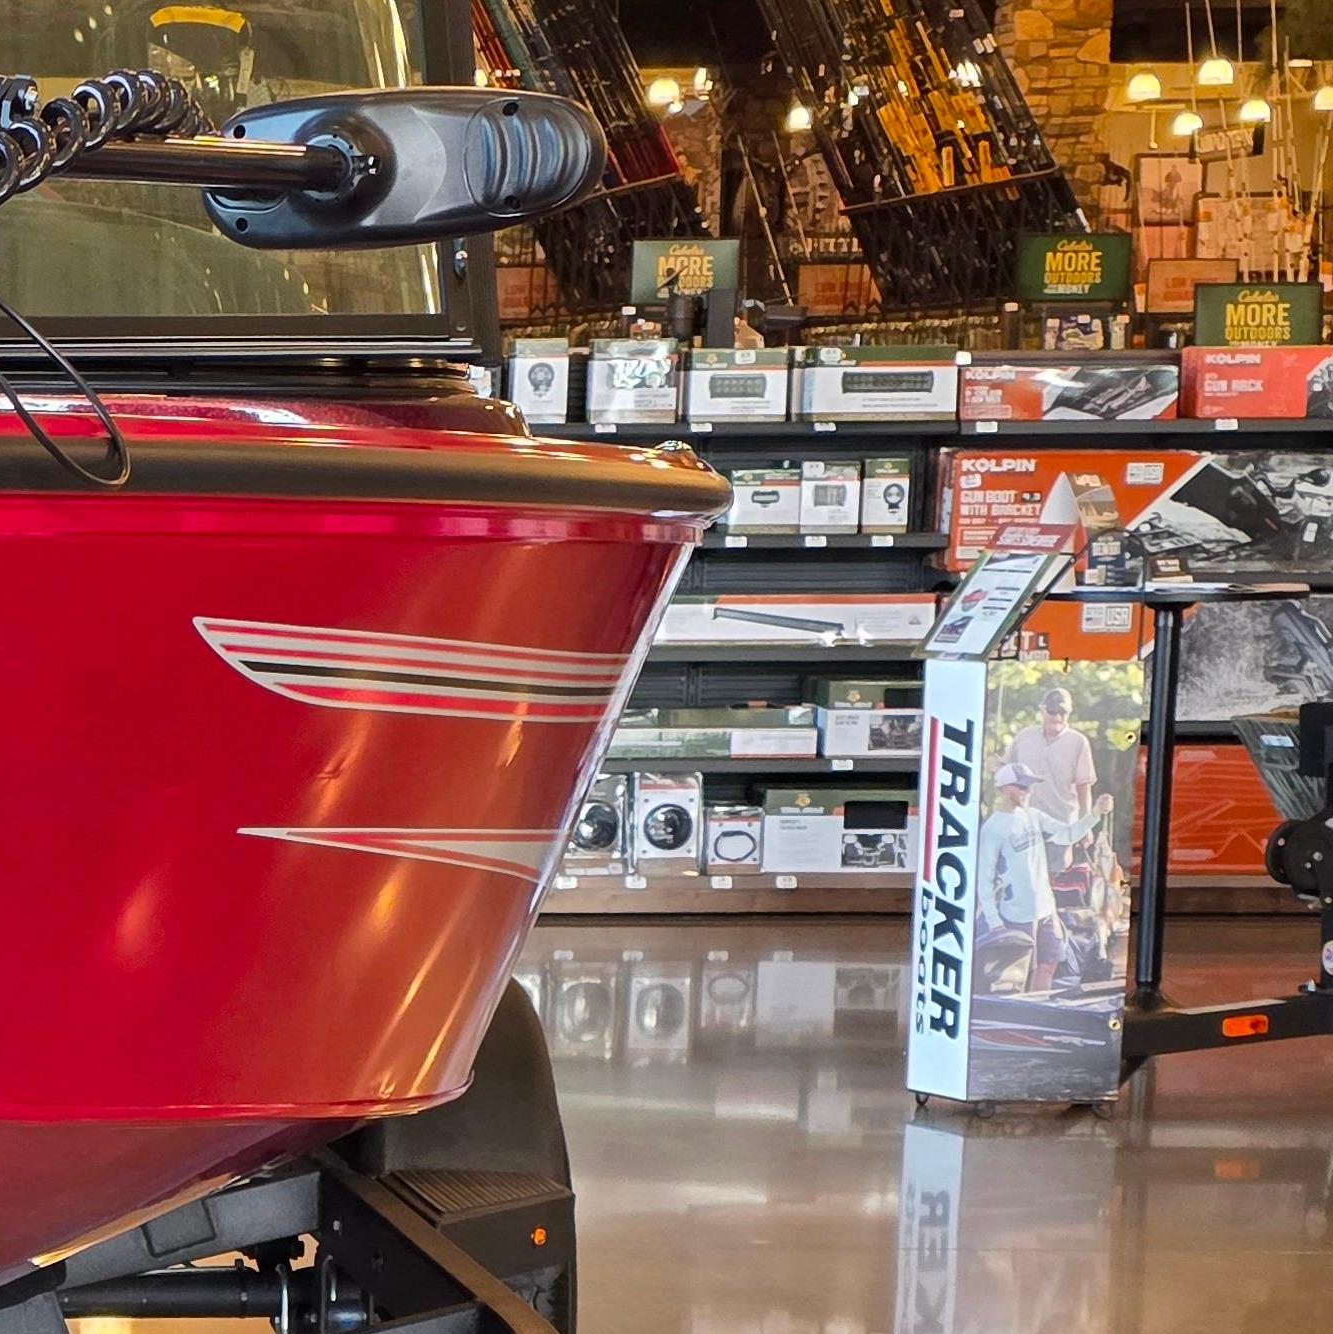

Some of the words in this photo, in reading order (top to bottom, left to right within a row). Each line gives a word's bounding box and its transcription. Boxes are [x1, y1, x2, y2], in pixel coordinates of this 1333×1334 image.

[657, 255, 713, 276] MORE
[1045, 251, 1102, 272] MORE
[1044, 271, 1102, 284] OUTDOORS
[1226, 304, 1291, 326] MORE
[1224, 326, 1291, 341] OUTDOORS
[961, 458, 1037, 472] KOLPIN
[961, 490, 984, 503] GUN
[986, 490, 1017, 503] BOOT
[960, 504, 988, 516] WITH
[991, 504, 1042, 516] BRACKET
[1108, 607, 1129, 626] USA
[930, 717, 975, 1040] TRACKER
[916, 886, 933, 1036] boats
